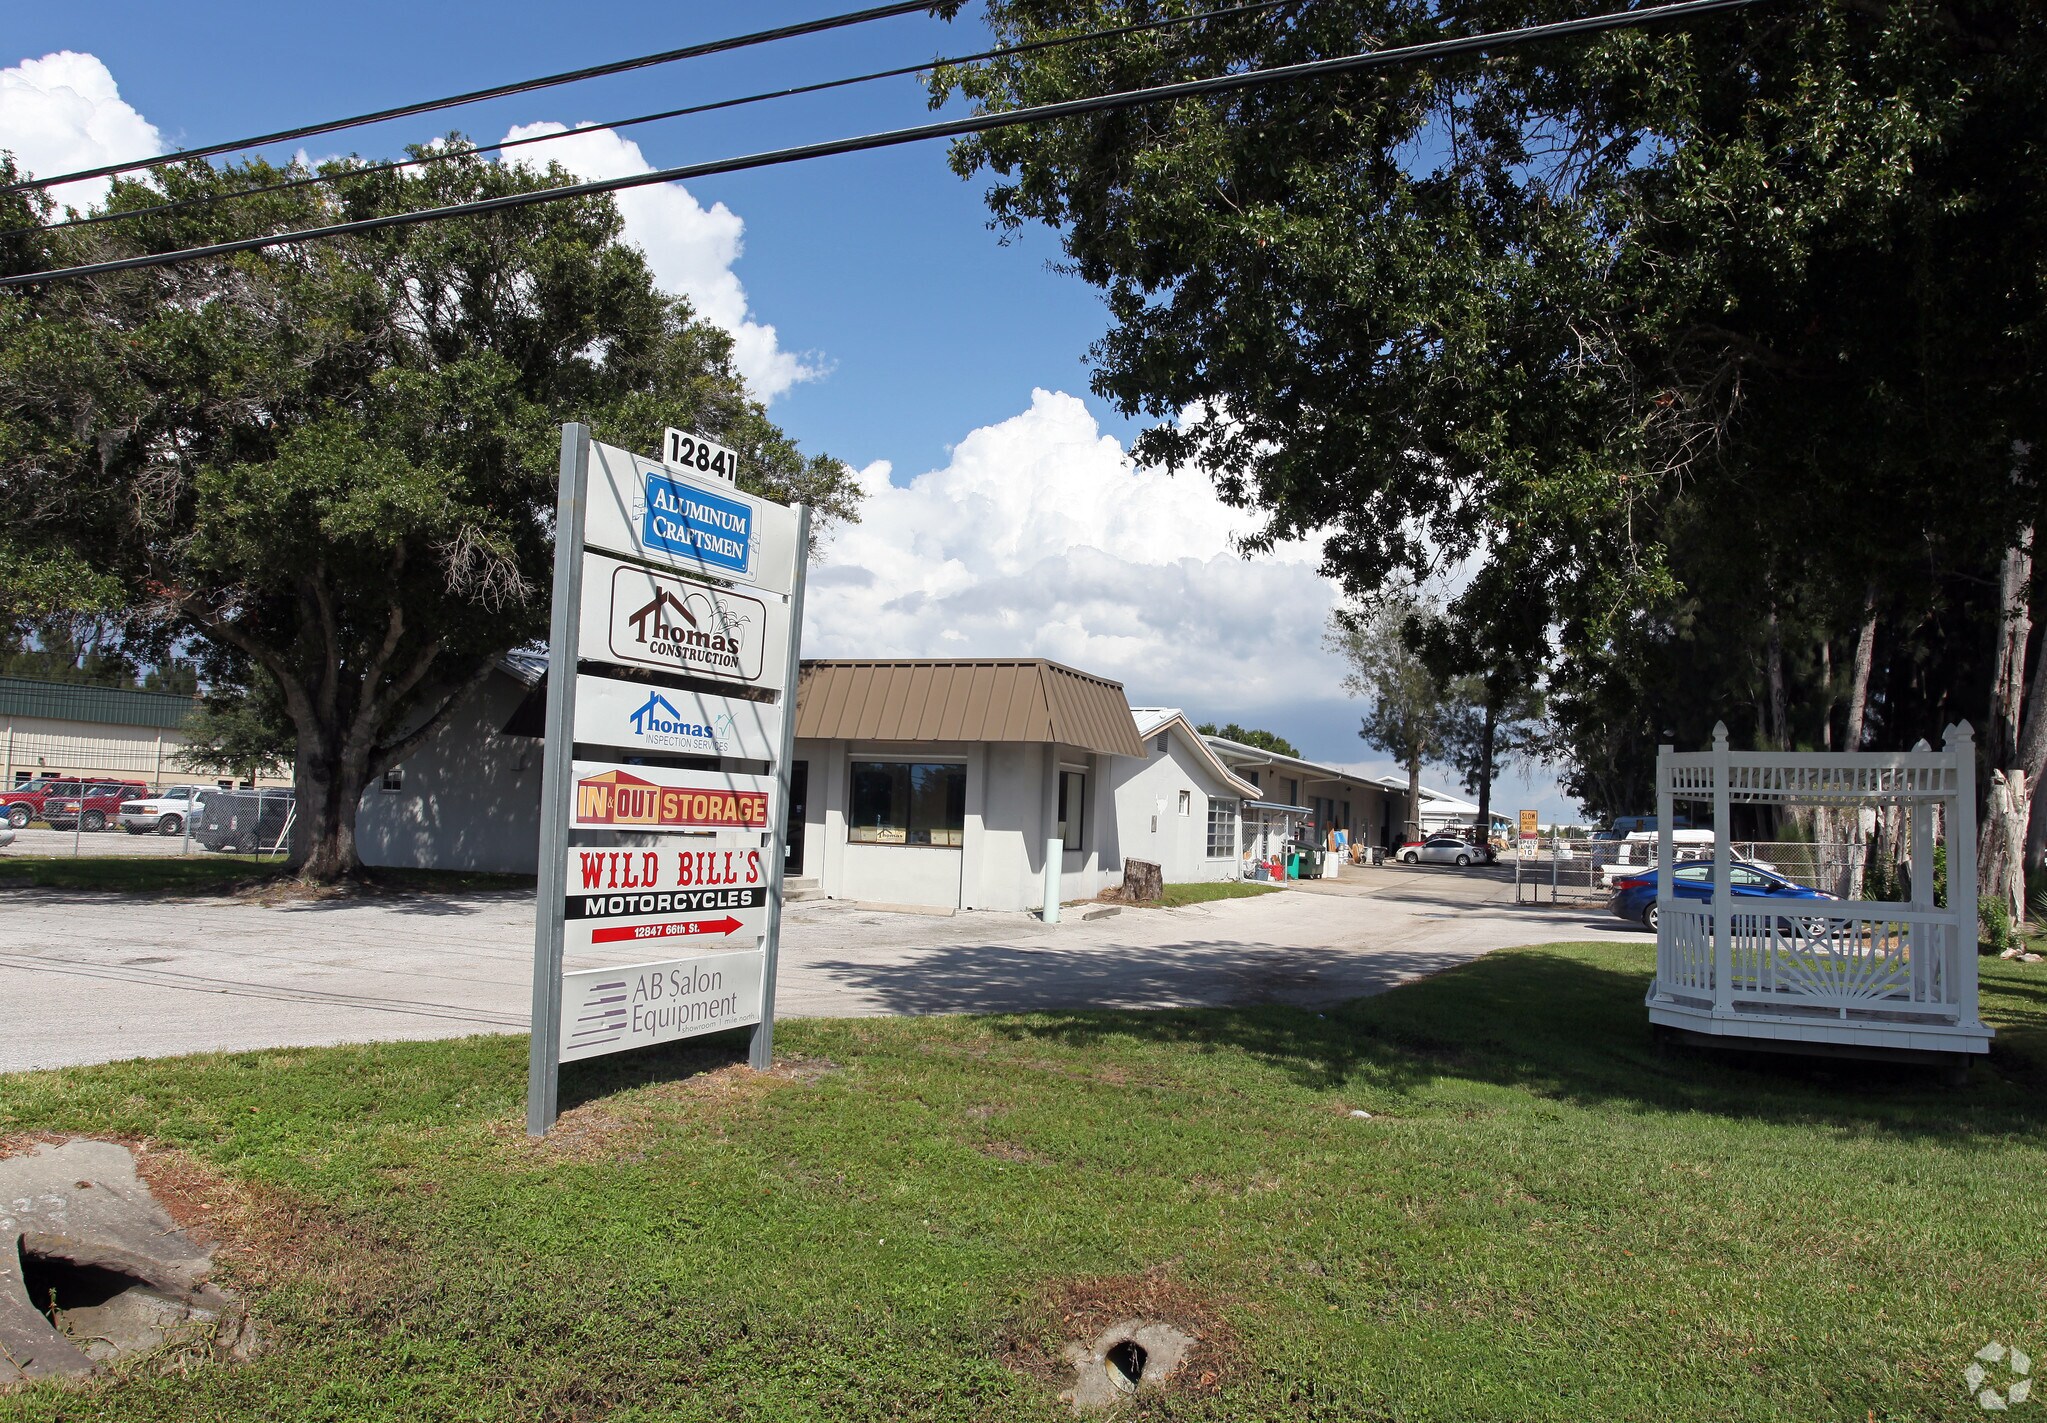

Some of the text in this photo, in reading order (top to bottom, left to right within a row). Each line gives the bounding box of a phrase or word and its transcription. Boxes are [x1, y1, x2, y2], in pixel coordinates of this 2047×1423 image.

[671, 433, 736, 482] 12841
[653, 488, 746, 535] ALUMINUM
[653, 516, 744, 560] CRAFTSMEN
[629, 587, 739, 655] Thomas
[650, 640, 739, 668] CONSTRUCTION
[630, 691, 713, 738] Thomas
[645, 734, 729, 752] INSPECTION SERVICES
[578, 785, 766, 822] IN & OUT STORAGE
[580, 851, 760, 889] WILD BILL'S
[585, 890, 753, 916] MOTORCYCLES
[634, 923, 701, 939] 12847 66th St.
[632, 965, 722, 1003] AB Salon
[632, 992, 738, 1037] Equipment
[682, 1021, 716, 1034] showroom
[724, 1016, 738, 1025] mile
[739, 1013, 755, 1022] north
